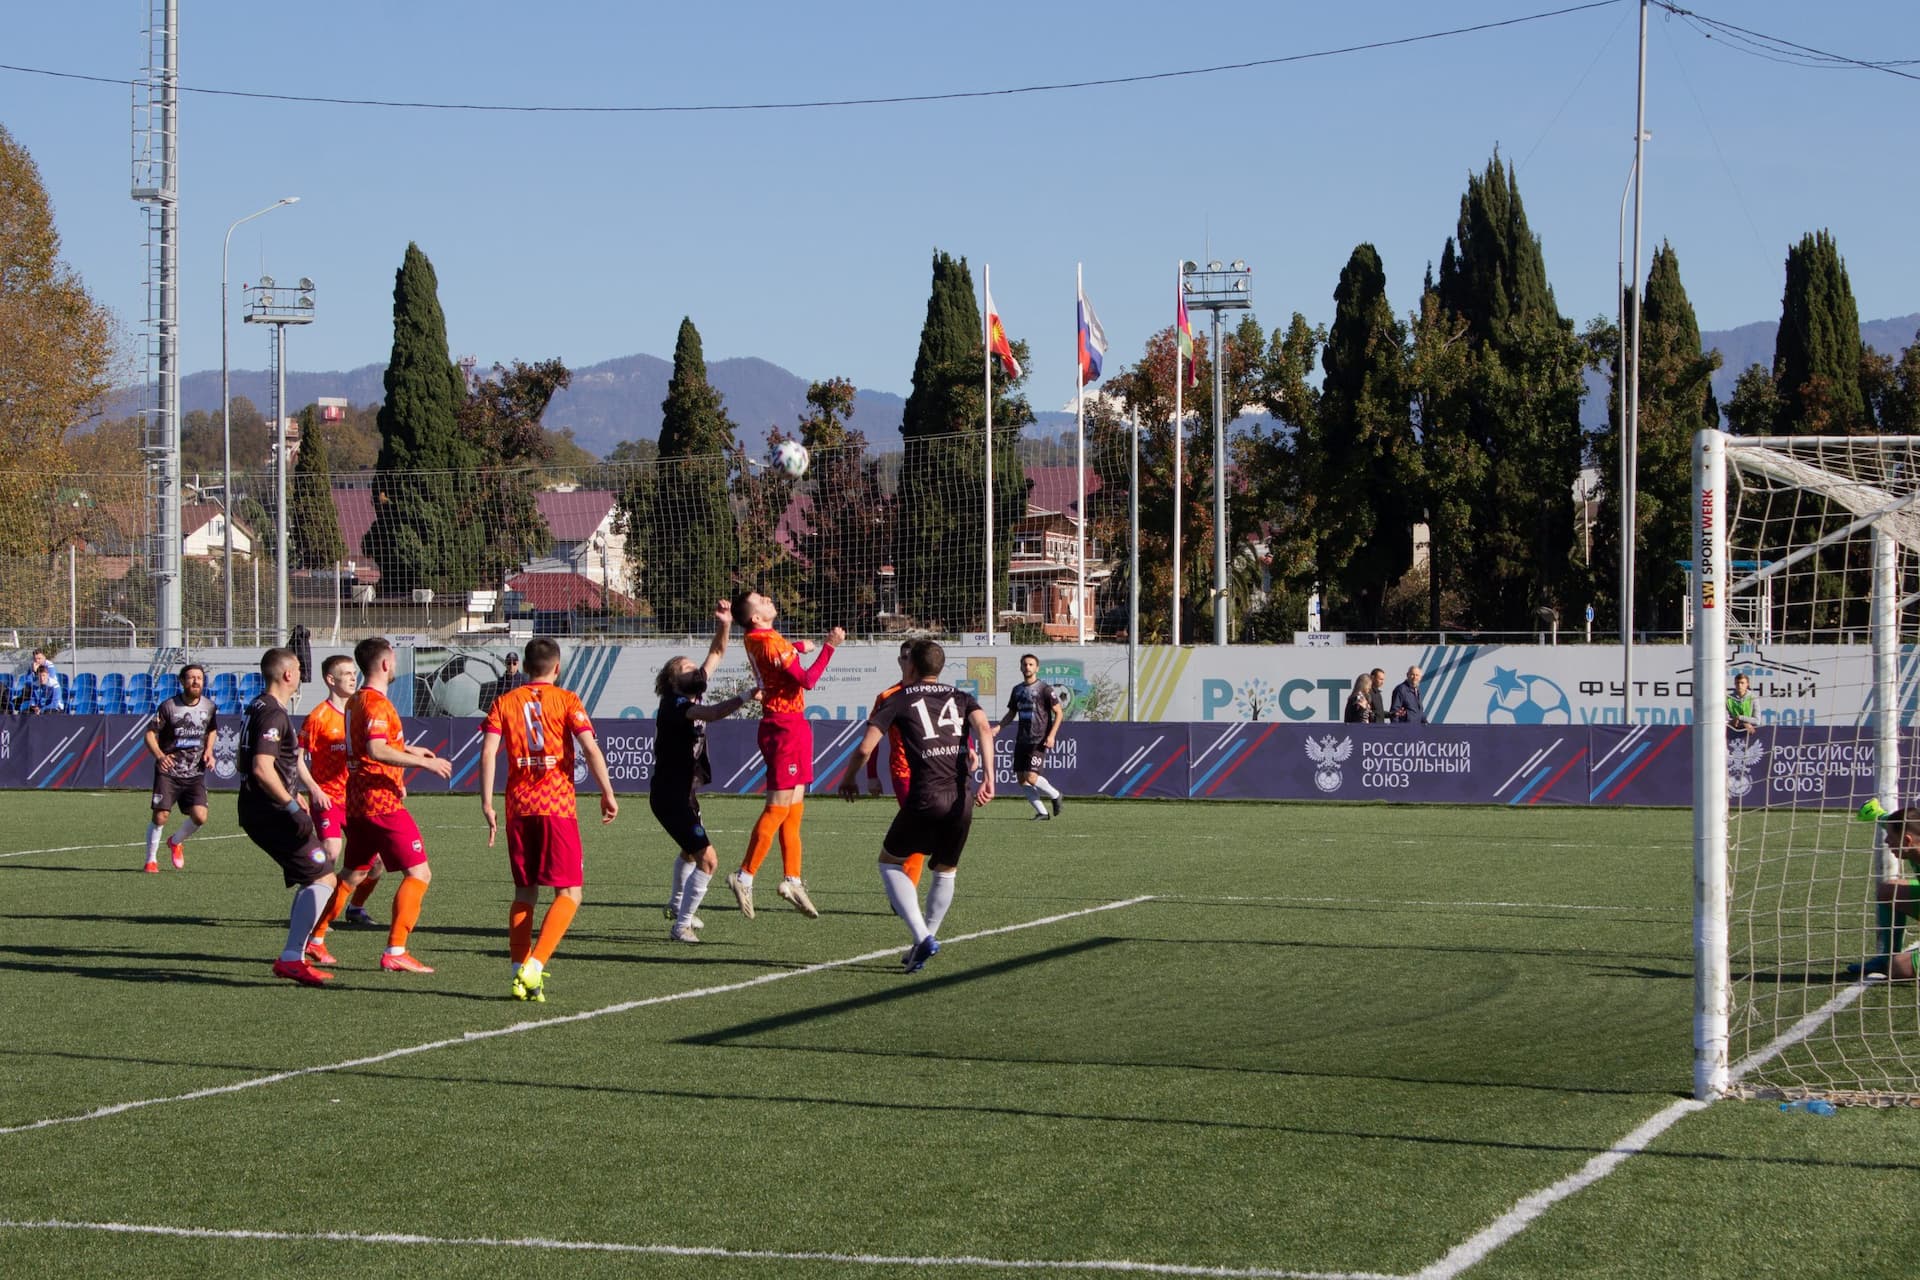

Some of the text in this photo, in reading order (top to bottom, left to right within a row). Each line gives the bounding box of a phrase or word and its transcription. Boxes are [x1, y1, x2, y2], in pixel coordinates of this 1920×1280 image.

[1702, 489, 1713, 575] SPORTWERK
[523, 700, 545, 751] 6
[910, 696, 964, 740] 14
[606, 736, 654, 751] РОССИ
[1362, 741, 1471, 758] РОССИЙСКИЙ
[1773, 744, 1875, 761] РОССИЙСКИ
[607, 766, 649, 780] СОЮЗ
[1362, 757, 1471, 773] ФУТБОЛЬНЫЙ
[1773, 760, 1875, 776] ФУТБОЛЬНЫ
[974, 769, 1018, 784] СЮЗ
[1362, 772, 1410, 788] СОЮЗ
[1773, 776, 1824, 792] СОЮЗ
